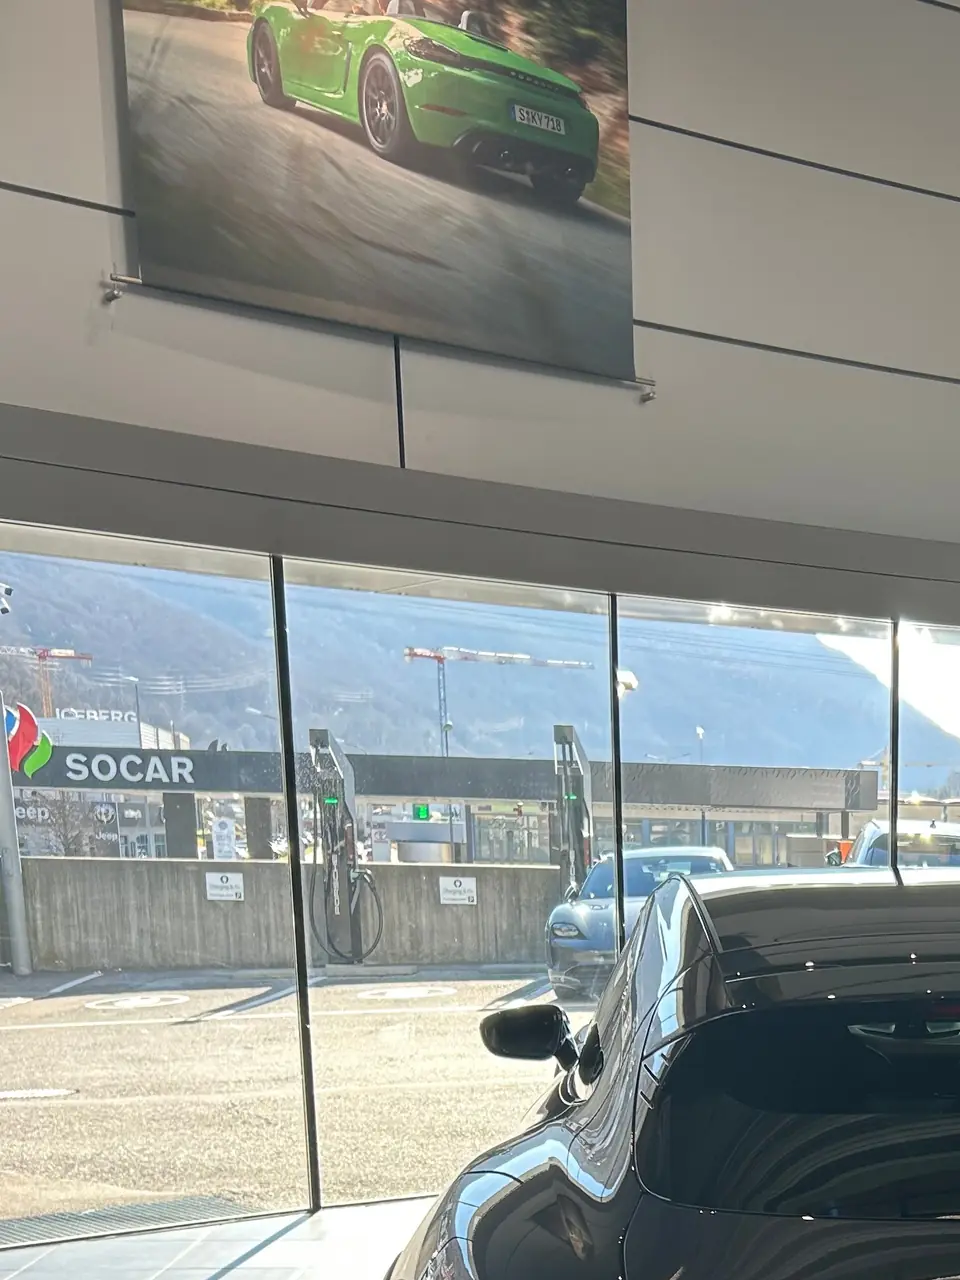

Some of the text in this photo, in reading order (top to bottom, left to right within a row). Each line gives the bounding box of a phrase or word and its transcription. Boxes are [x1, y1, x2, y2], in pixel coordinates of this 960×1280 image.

[544, 115, 562, 132] 718
[65, 753, 195, 783] SOCAR
[15, 806, 50, 821] eep
[95, 831, 118, 841] Jeep
